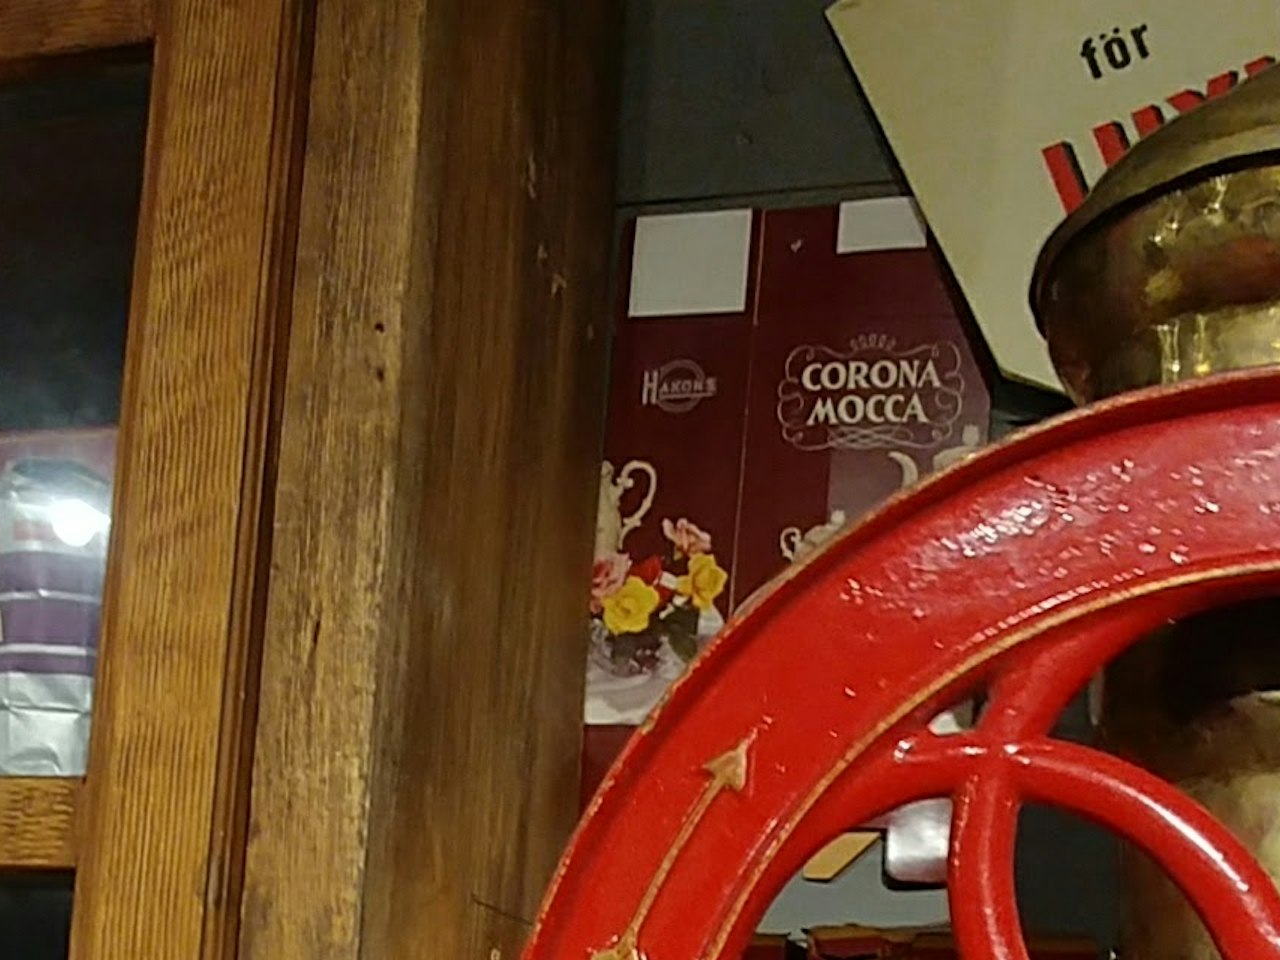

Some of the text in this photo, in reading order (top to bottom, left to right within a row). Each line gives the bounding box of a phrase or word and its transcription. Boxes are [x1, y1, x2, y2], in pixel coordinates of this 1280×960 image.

[1081, 24, 1149, 80] för
[801, 359, 941, 391] CORONA
[806, 393, 929, 426] MOCCA
